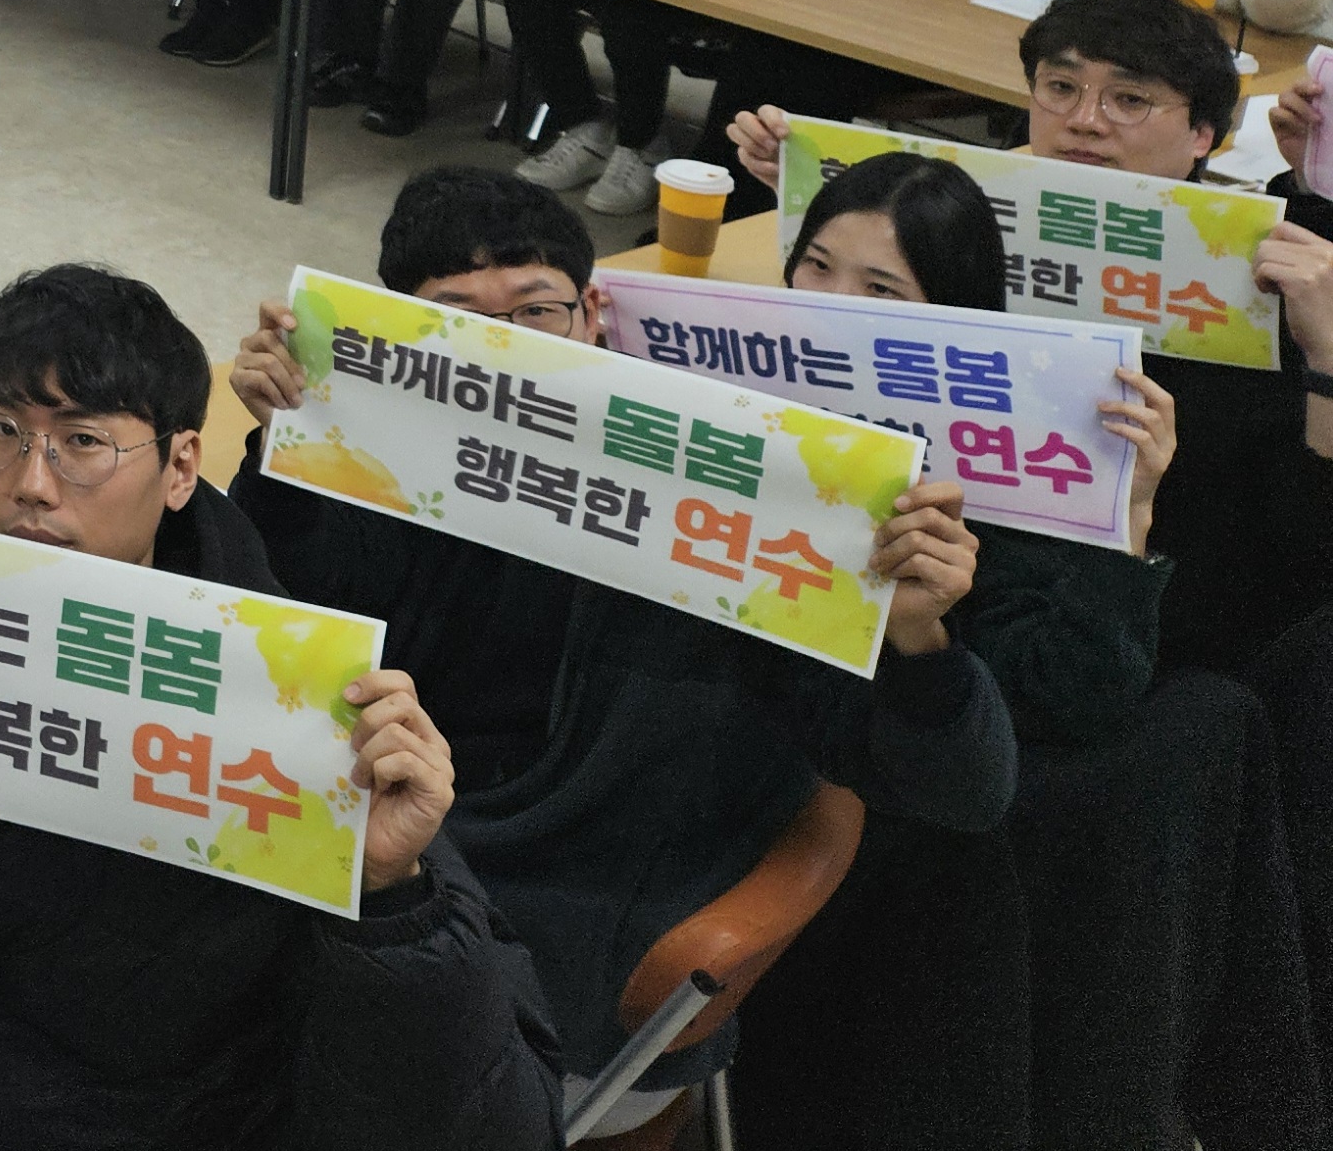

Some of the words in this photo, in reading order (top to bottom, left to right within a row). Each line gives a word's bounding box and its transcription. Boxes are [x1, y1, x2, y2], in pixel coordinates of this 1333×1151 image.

[1037, 189, 1165, 260] 돌봄
[1100, 264, 1229, 335] 연수
[330, 324, 578, 442] 함께하는
[602, 393, 767, 500] 돌봄
[639, 316, 854, 392] 함께하는
[872, 337, 1014, 414] 돌봄
[948, 419, 1094, 495] 연수
[454, 436, 651, 548] 행복한
[670, 497, 834, 602] 연수
[55, 598, 223, 716] 돌봄
[132, 722, 303, 834] 연수
